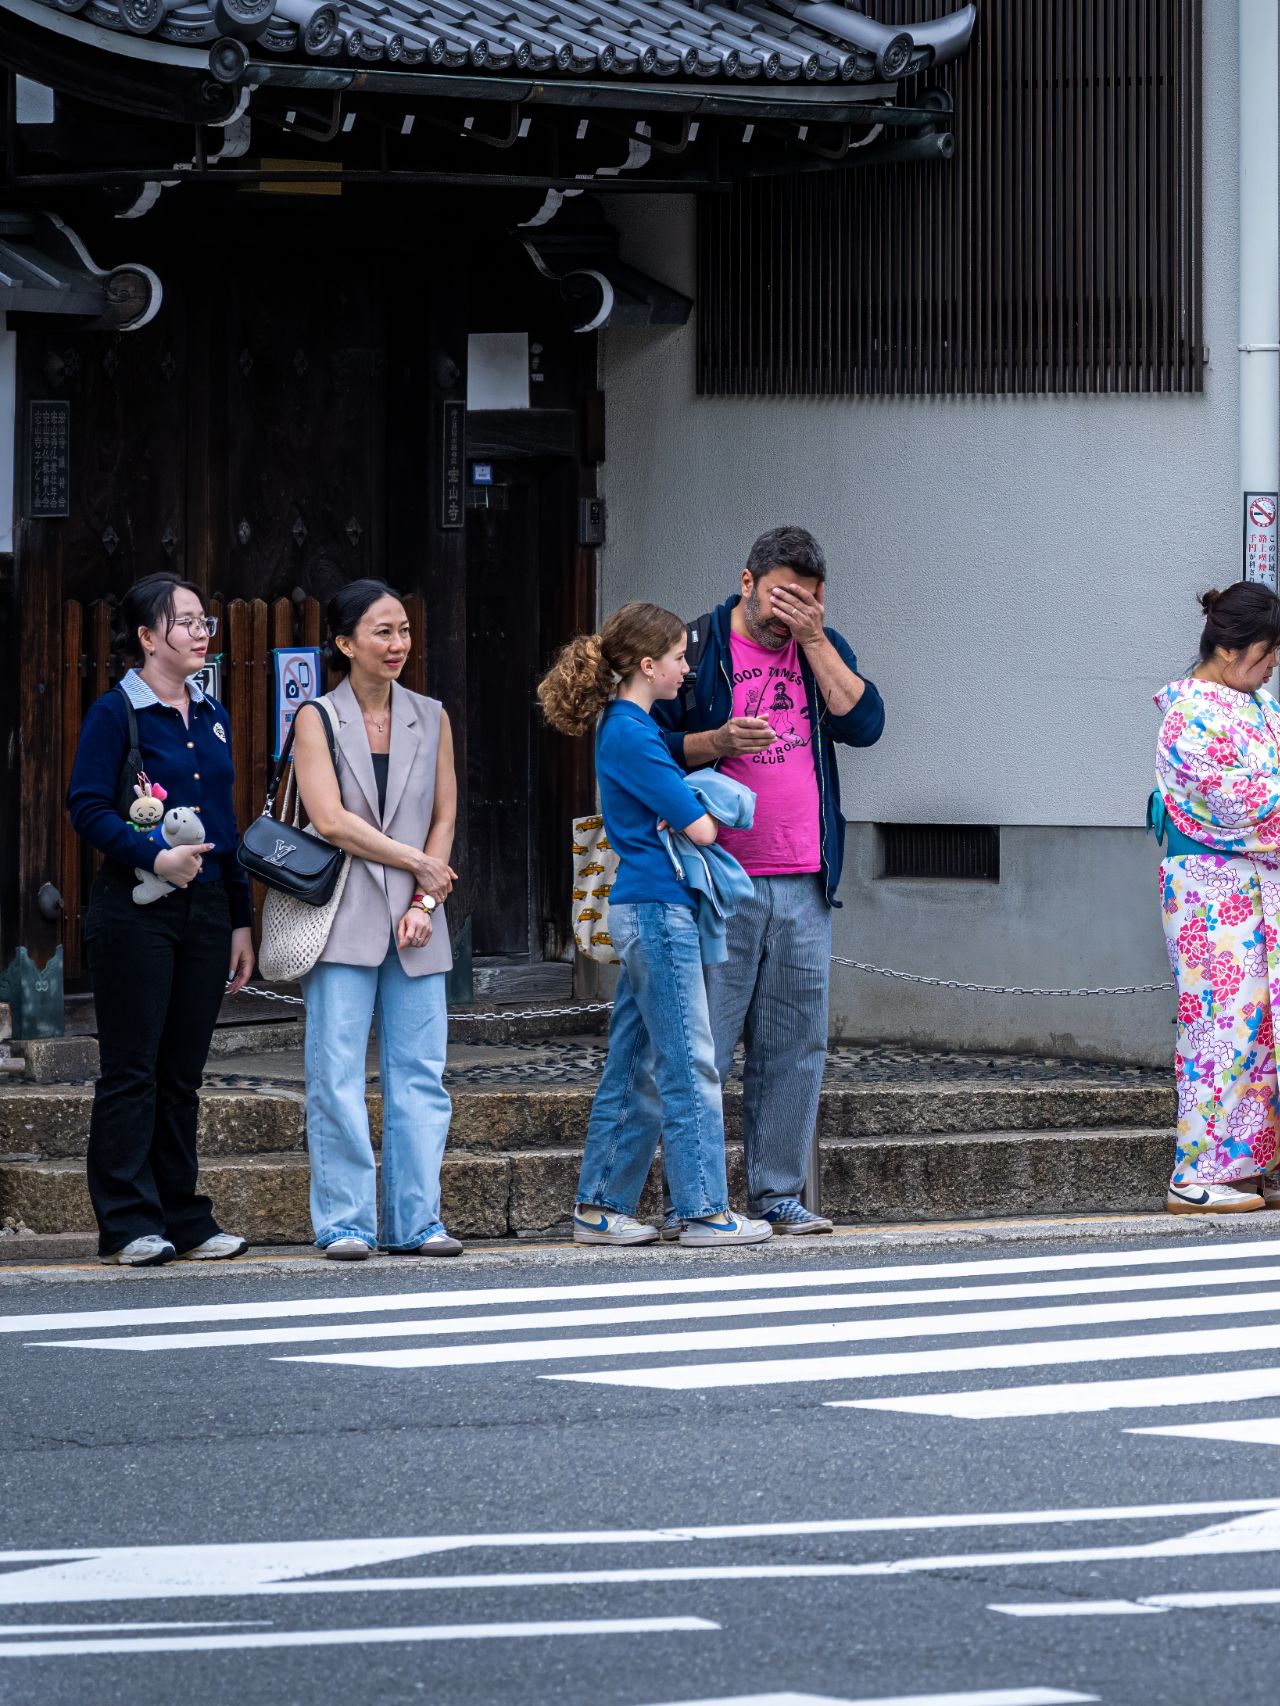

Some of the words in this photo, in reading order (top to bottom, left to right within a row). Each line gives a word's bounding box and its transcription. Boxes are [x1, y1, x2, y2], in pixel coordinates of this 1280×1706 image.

[1258, 534, 1267, 585] 路上喫煙す
[768, 667, 802, 686] TIMES
[752, 755, 785, 764] CLUB
